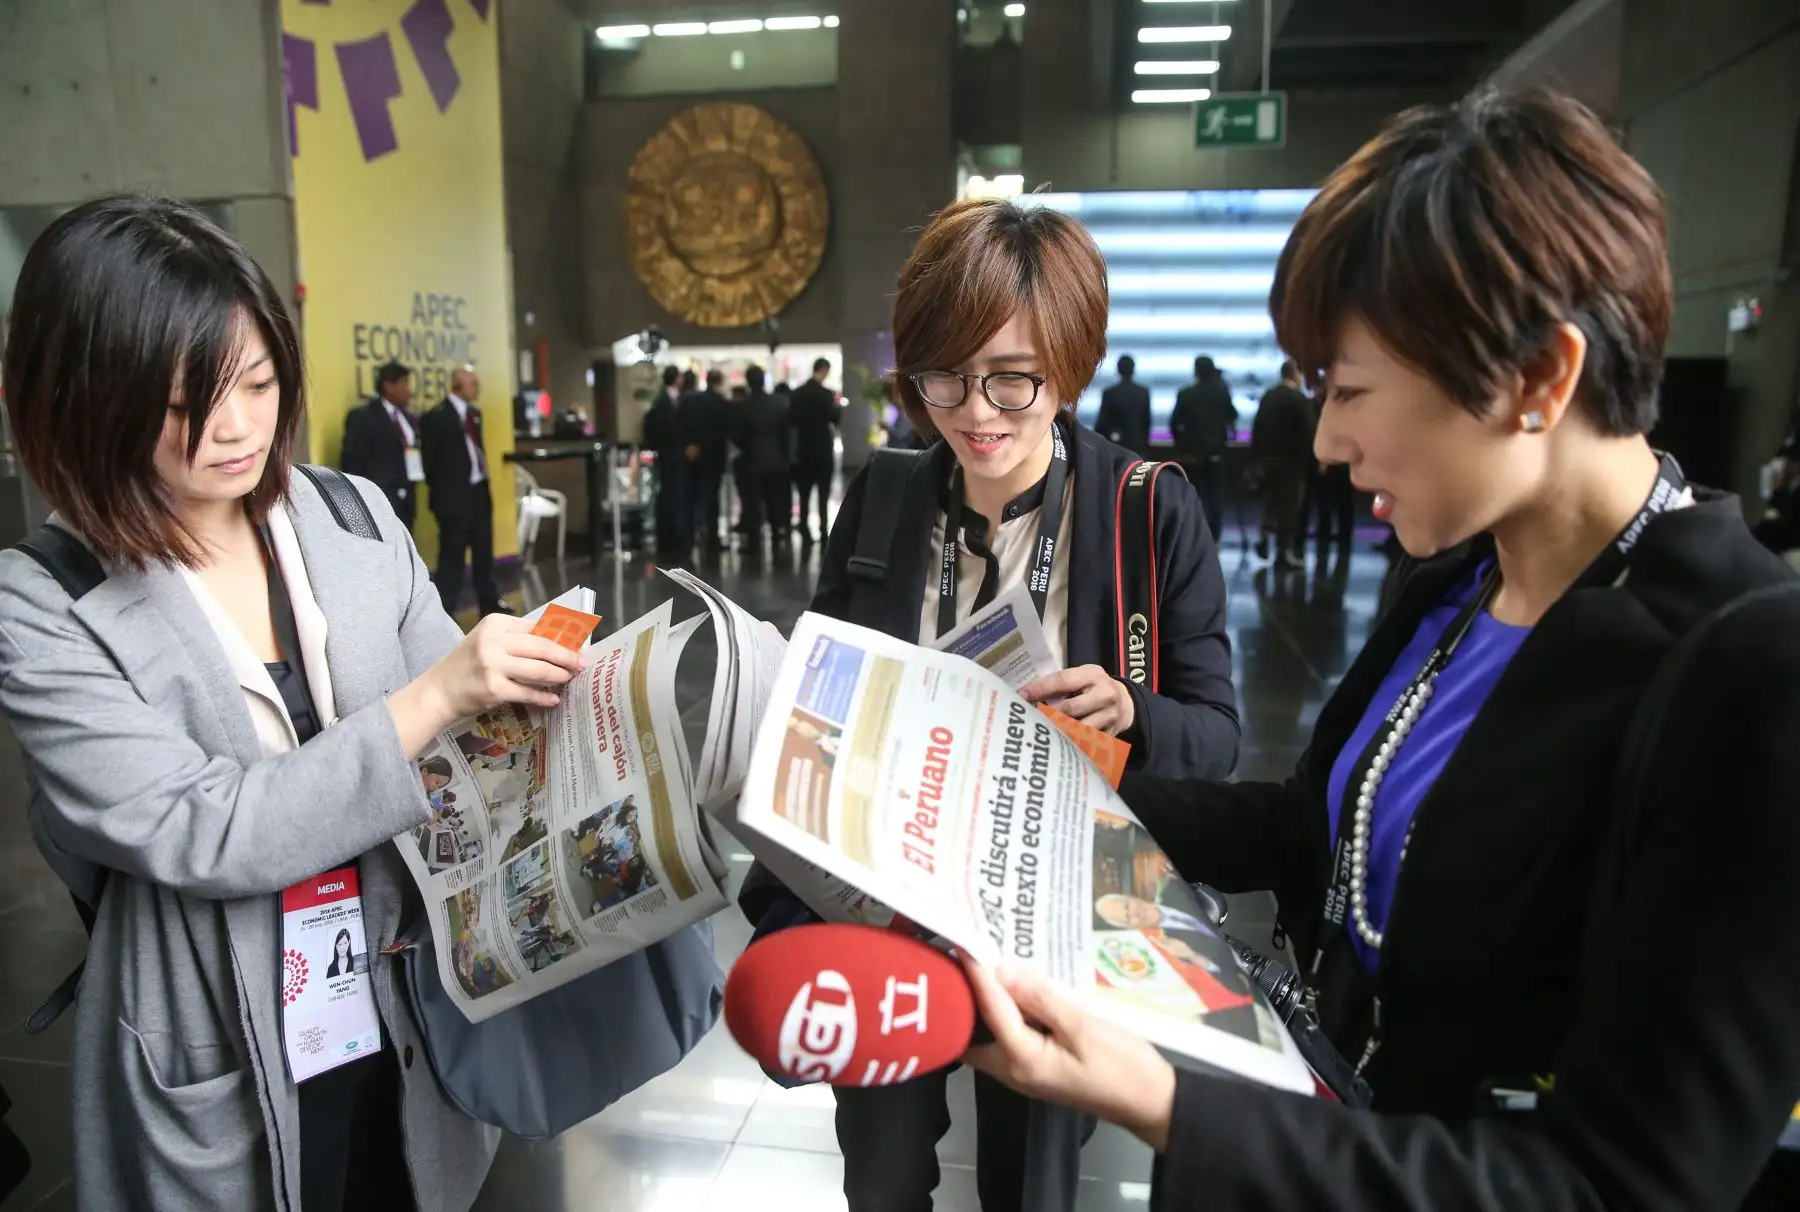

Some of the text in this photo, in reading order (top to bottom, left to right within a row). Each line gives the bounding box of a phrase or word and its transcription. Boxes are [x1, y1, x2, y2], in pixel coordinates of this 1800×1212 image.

[411, 291, 468, 330] APEC
[354, 323, 477, 366] ECONOMIC
[941, 571, 949, 596] APEC
[1030, 569, 1040, 591] 2016
[1038, 537, 1054, 592] APEC PERU
[593, 662, 605, 678] la
[1128, 612, 1148, 685] Cano
[592, 679, 608, 753] marinera
[605, 648, 627, 782] Al ritmo del cajón
[904, 726, 954, 847] Peruano
[980, 774, 1017, 888] discutirá
[1002, 700, 1027, 773] nuevo
[1022, 722, 1050, 848] económico
[902, 842, 935, 875] El
[1332, 840, 1352, 925] APEC PERU
[317, 881, 345, 896] MEDIA
[1011, 852, 1039, 959] contexto
[302, 916, 327, 926] ECONOMIC
[347, 907, 360, 915] WEEK
[336, 985, 350, 994] YANG
